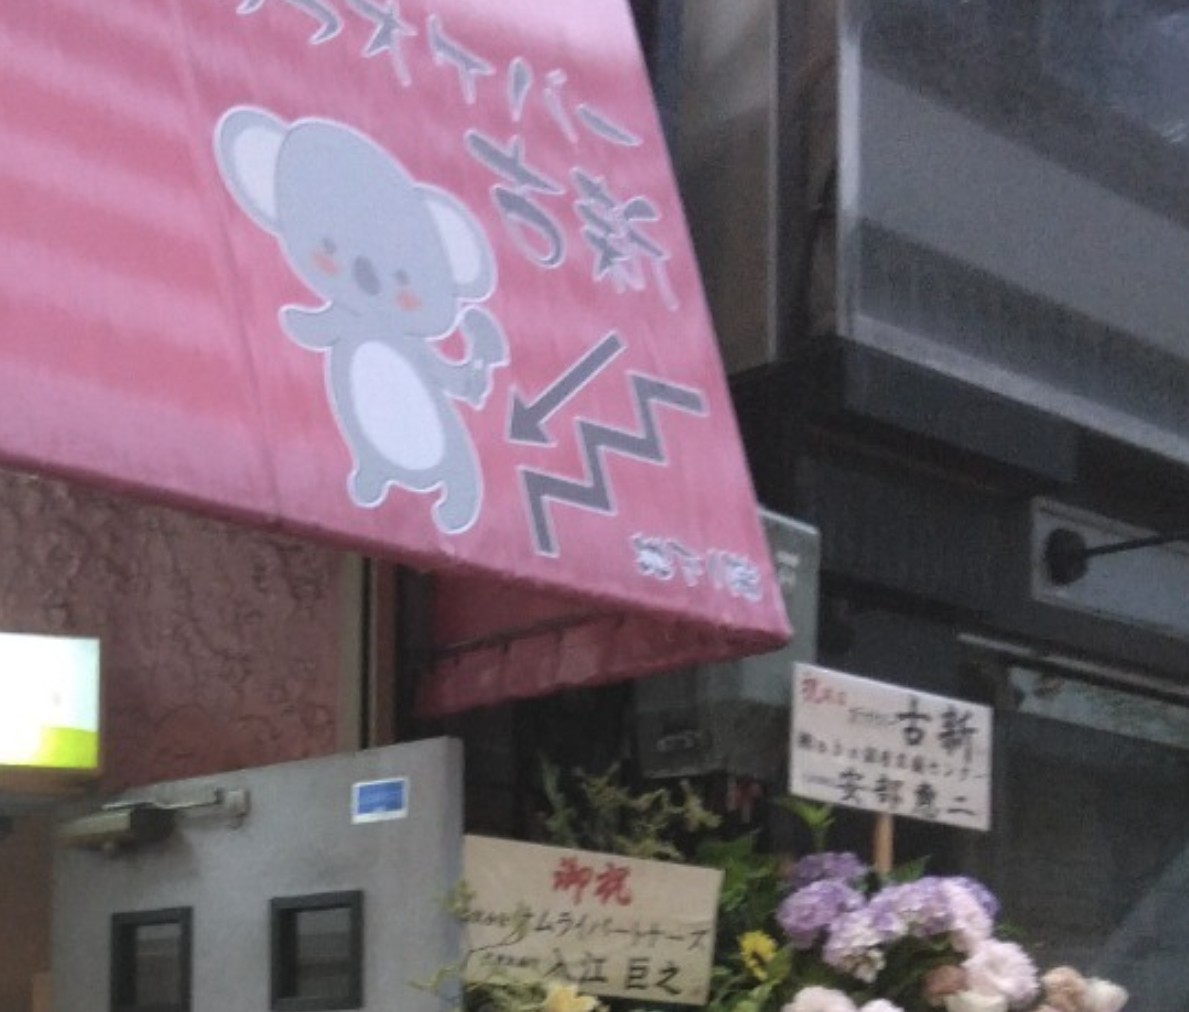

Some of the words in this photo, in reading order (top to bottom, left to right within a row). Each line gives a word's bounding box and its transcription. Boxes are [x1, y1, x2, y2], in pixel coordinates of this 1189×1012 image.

[236, 0, 643, 146] オケバー
[552, 857, 633, 906] 御祝
